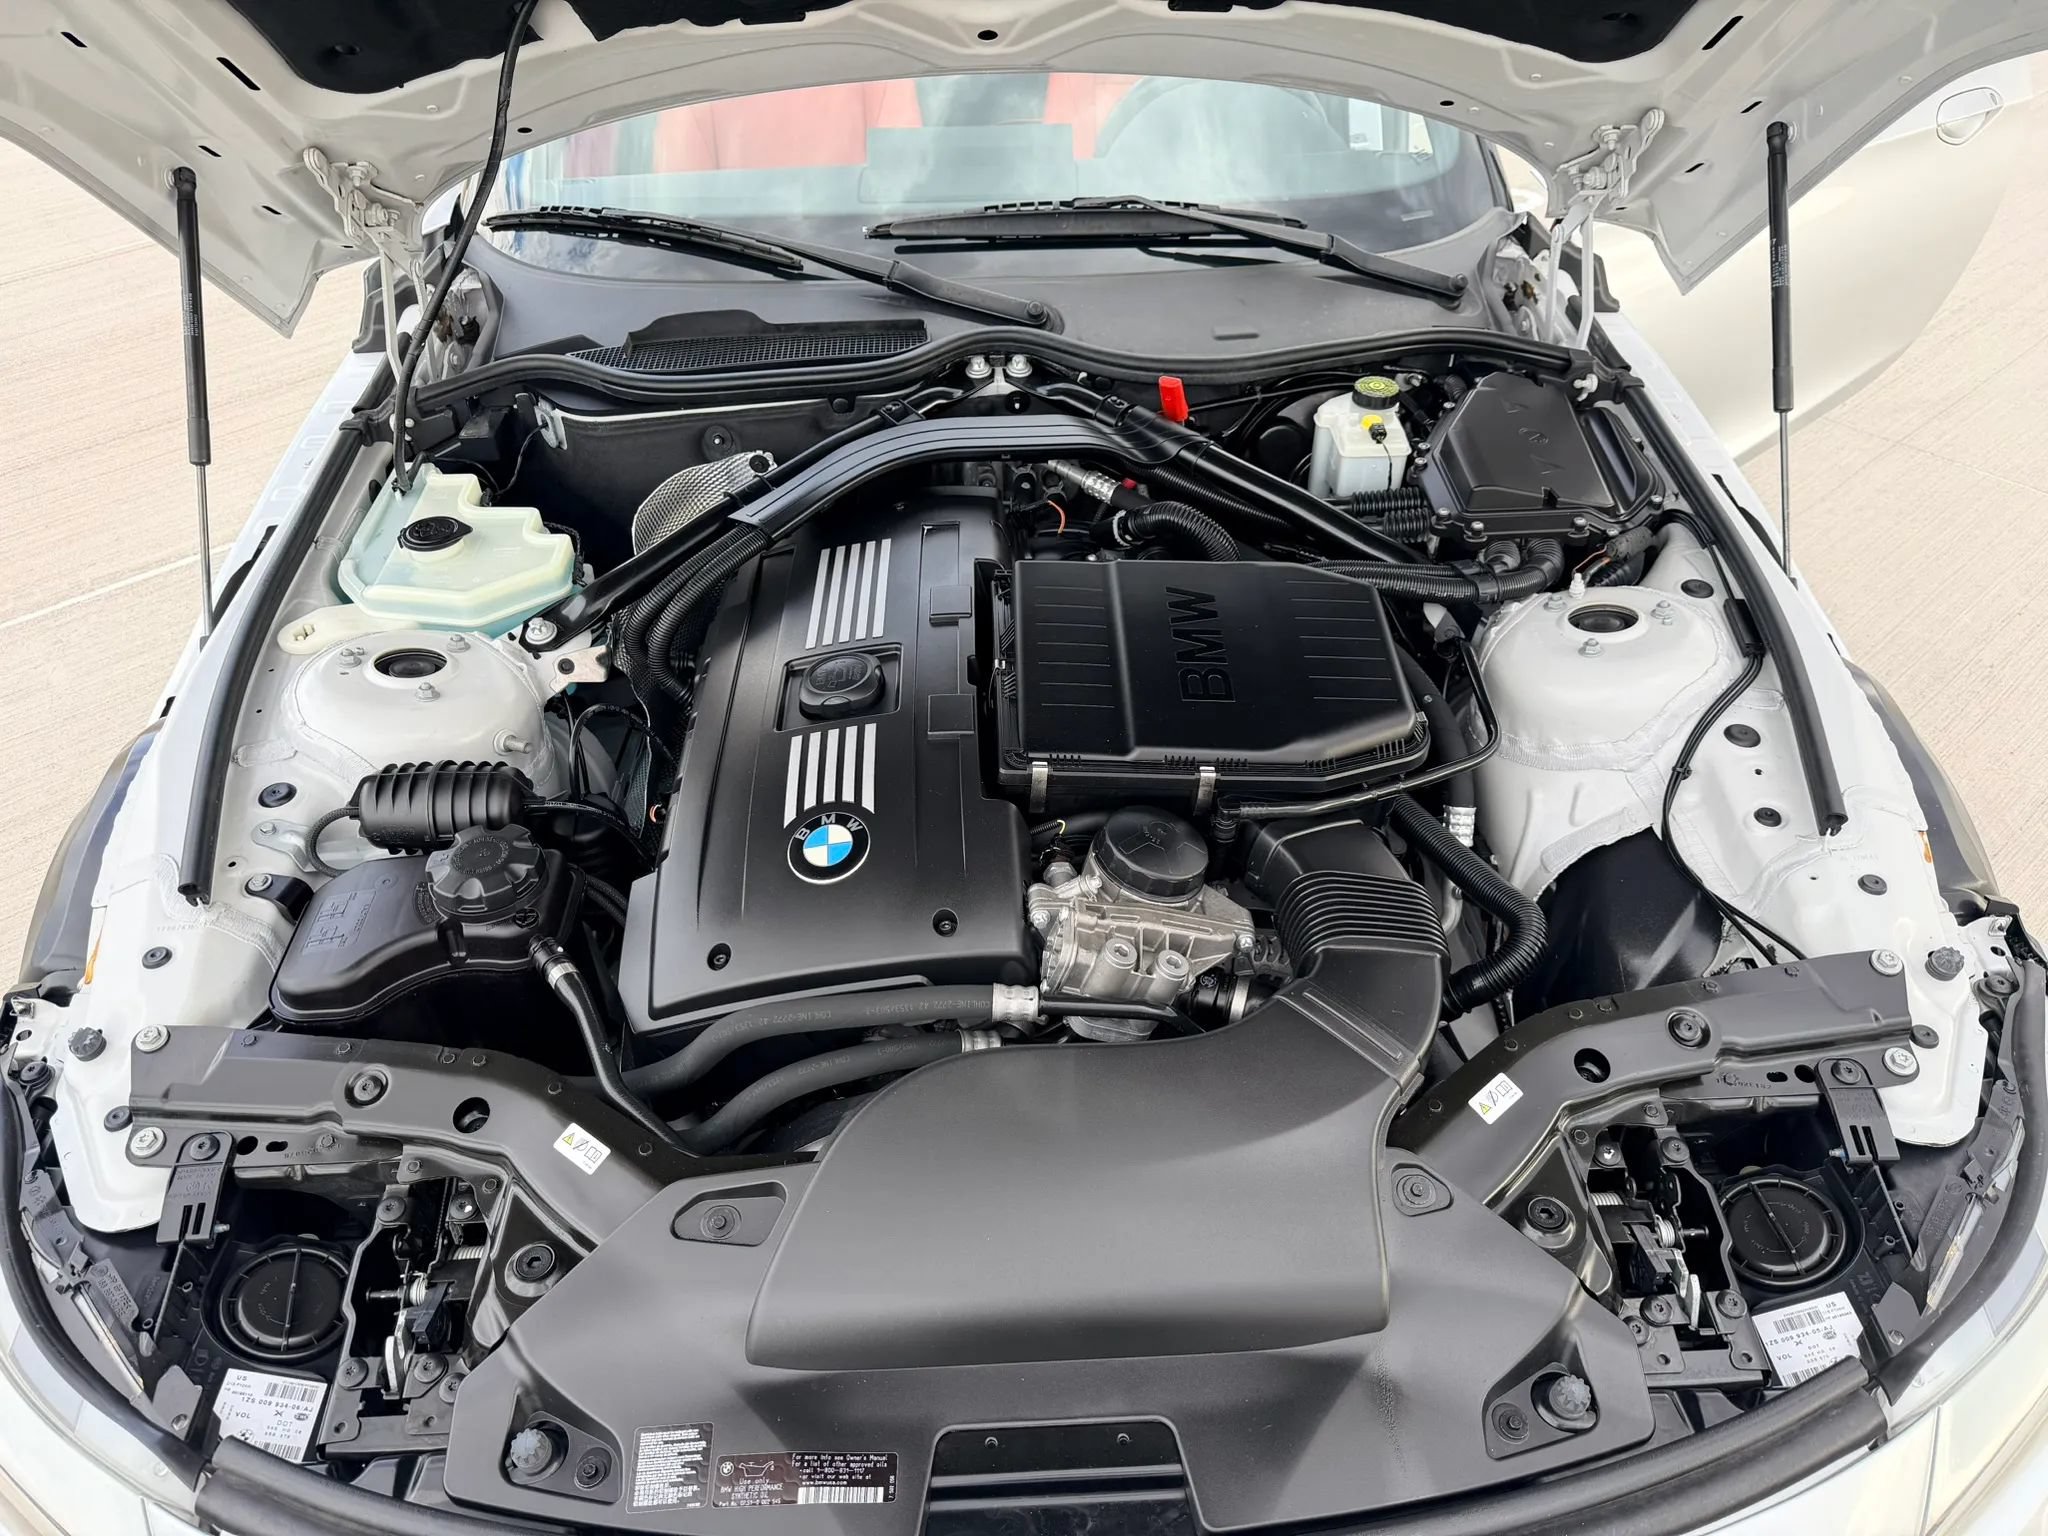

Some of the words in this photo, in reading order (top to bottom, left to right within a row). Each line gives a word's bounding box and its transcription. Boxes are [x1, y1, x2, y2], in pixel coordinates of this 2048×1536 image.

[1165, 585, 1236, 702] BMW
[795, 813, 863, 841] BMW
[235, 1411, 252, 1419] VOL
